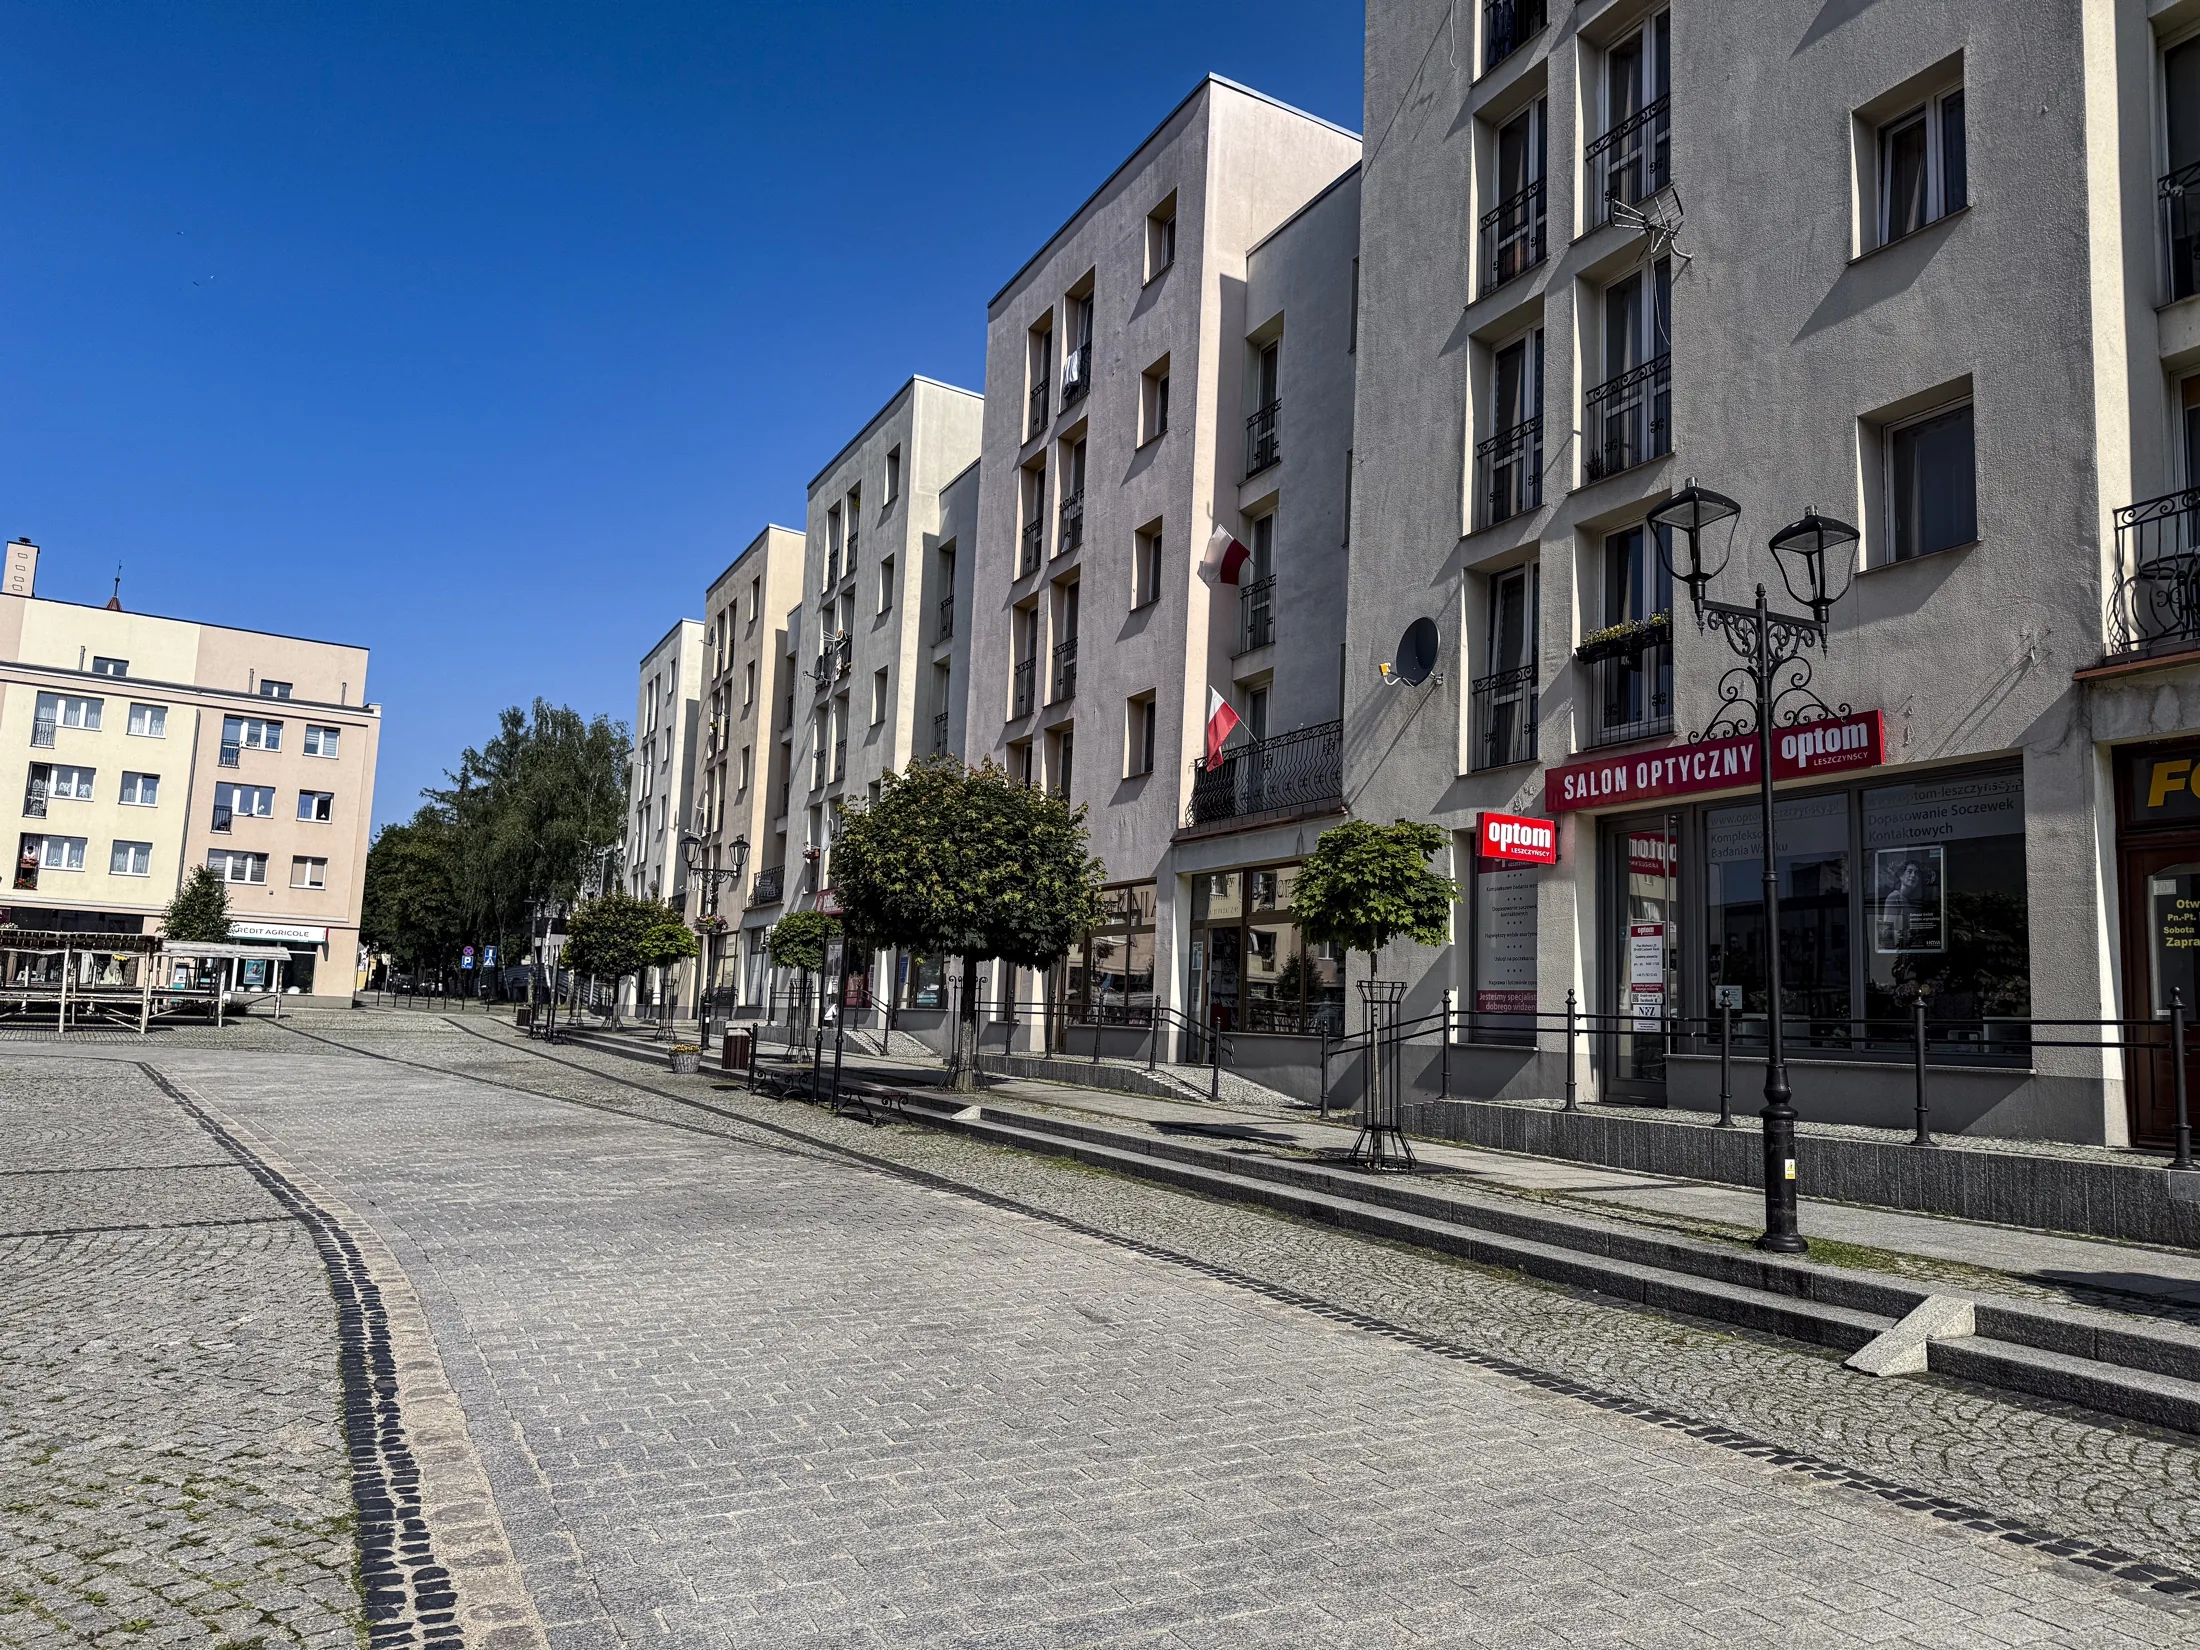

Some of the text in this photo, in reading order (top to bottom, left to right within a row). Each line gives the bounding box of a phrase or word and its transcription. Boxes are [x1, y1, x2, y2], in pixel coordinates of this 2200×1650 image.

[1781, 722, 1868, 768] optom
[1564, 743, 1754, 800] SALON OPTYCZNY
[1868, 798, 2015, 826] Dopasowanie Soczewek
[1488, 822, 1551, 852] optom
[1711, 829, 1778, 844] Kompleksoe
[1868, 822, 1953, 842] Kontaktowych
[1711, 842, 1788, 858] Badania Wzku
[265, 929, 309, 937] AGRICOLE
[2163, 926, 2195, 934] Sobota
[1479, 992, 1506, 1002] Jesteśmy
[1485, 1002, 1512, 1011] dobrego
[1639, 1006, 1656, 1016] NFZ
